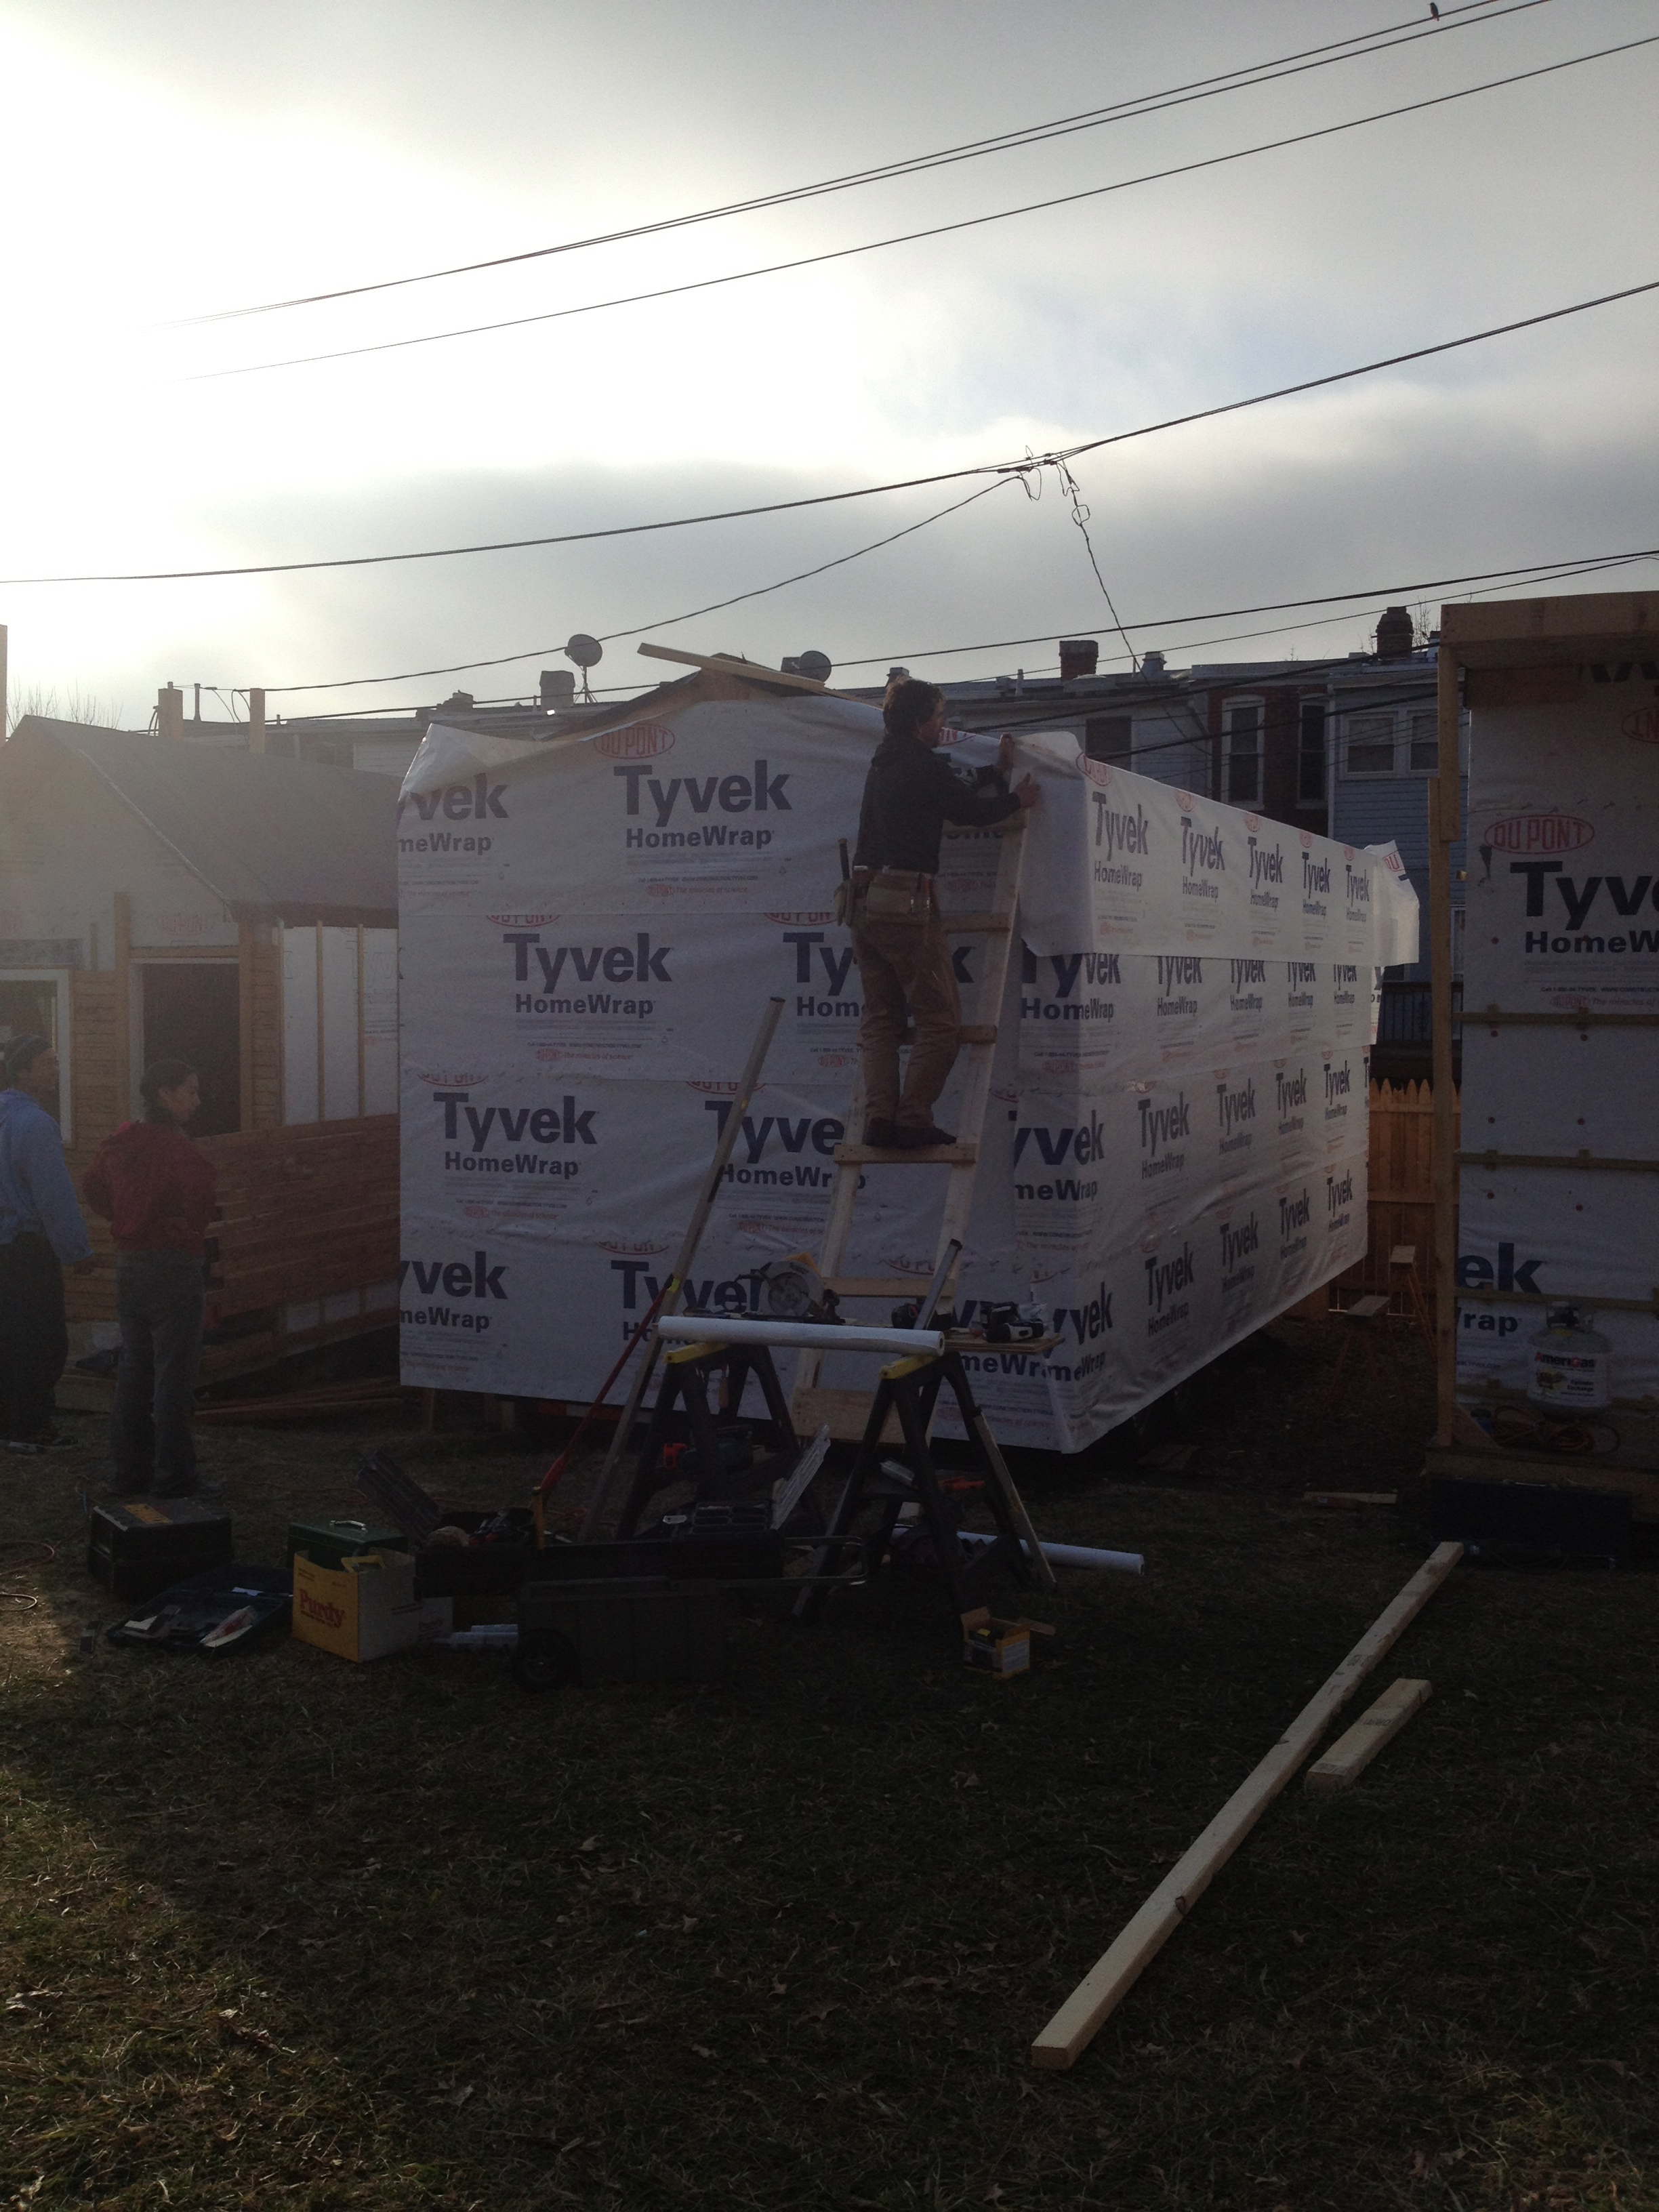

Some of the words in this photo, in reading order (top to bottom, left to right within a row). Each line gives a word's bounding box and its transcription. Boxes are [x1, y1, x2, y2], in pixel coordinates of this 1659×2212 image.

[398, 773, 509, 821] vek
[613, 760, 792, 827] Tyvek
[626, 825, 773, 850] HomeWrap
[1092, 792, 1148, 861] Tyvek
[1181, 816, 1225, 876] Tyvek
[1094, 861, 1143, 891] HomeWrap
[1248, 836, 1283, 889] Tyvek
[1302, 851, 1330, 899] Tyvek
[1345, 865, 1370, 907] Tyvek
[1510, 861, 1658, 930] Tyv
[504, 933, 673, 994] Tyvek
[516, 994, 654, 1019] HomeWrap
[1021, 998, 1113, 1023] HomeWrap
[1158, 996, 1197, 1017] HomeWrap
[1216, 1078, 1256, 1135] Tyvek
[1276, 1068, 1307, 1118] Tyvek
[1324, 1060, 1350, 1106] Tyvek
[433, 1092, 598, 1152] Tyvek
[705, 1101, 846, 1164] Tyve
[1138, 1091, 1190, 1158] Tyvek
[445, 1151, 579, 1179] HomeWrap
[1279, 1188, 1310, 1242] Tyvek
[1327, 1169, 1353, 1217] Tyvek
[1220, 1211, 1258, 1273] Tyvek
[1145, 1242, 1194, 1313] Tyvek
[1458, 1308, 1518, 1336] rap
[1534, 1351, 1595, 1368] AmeriGas
